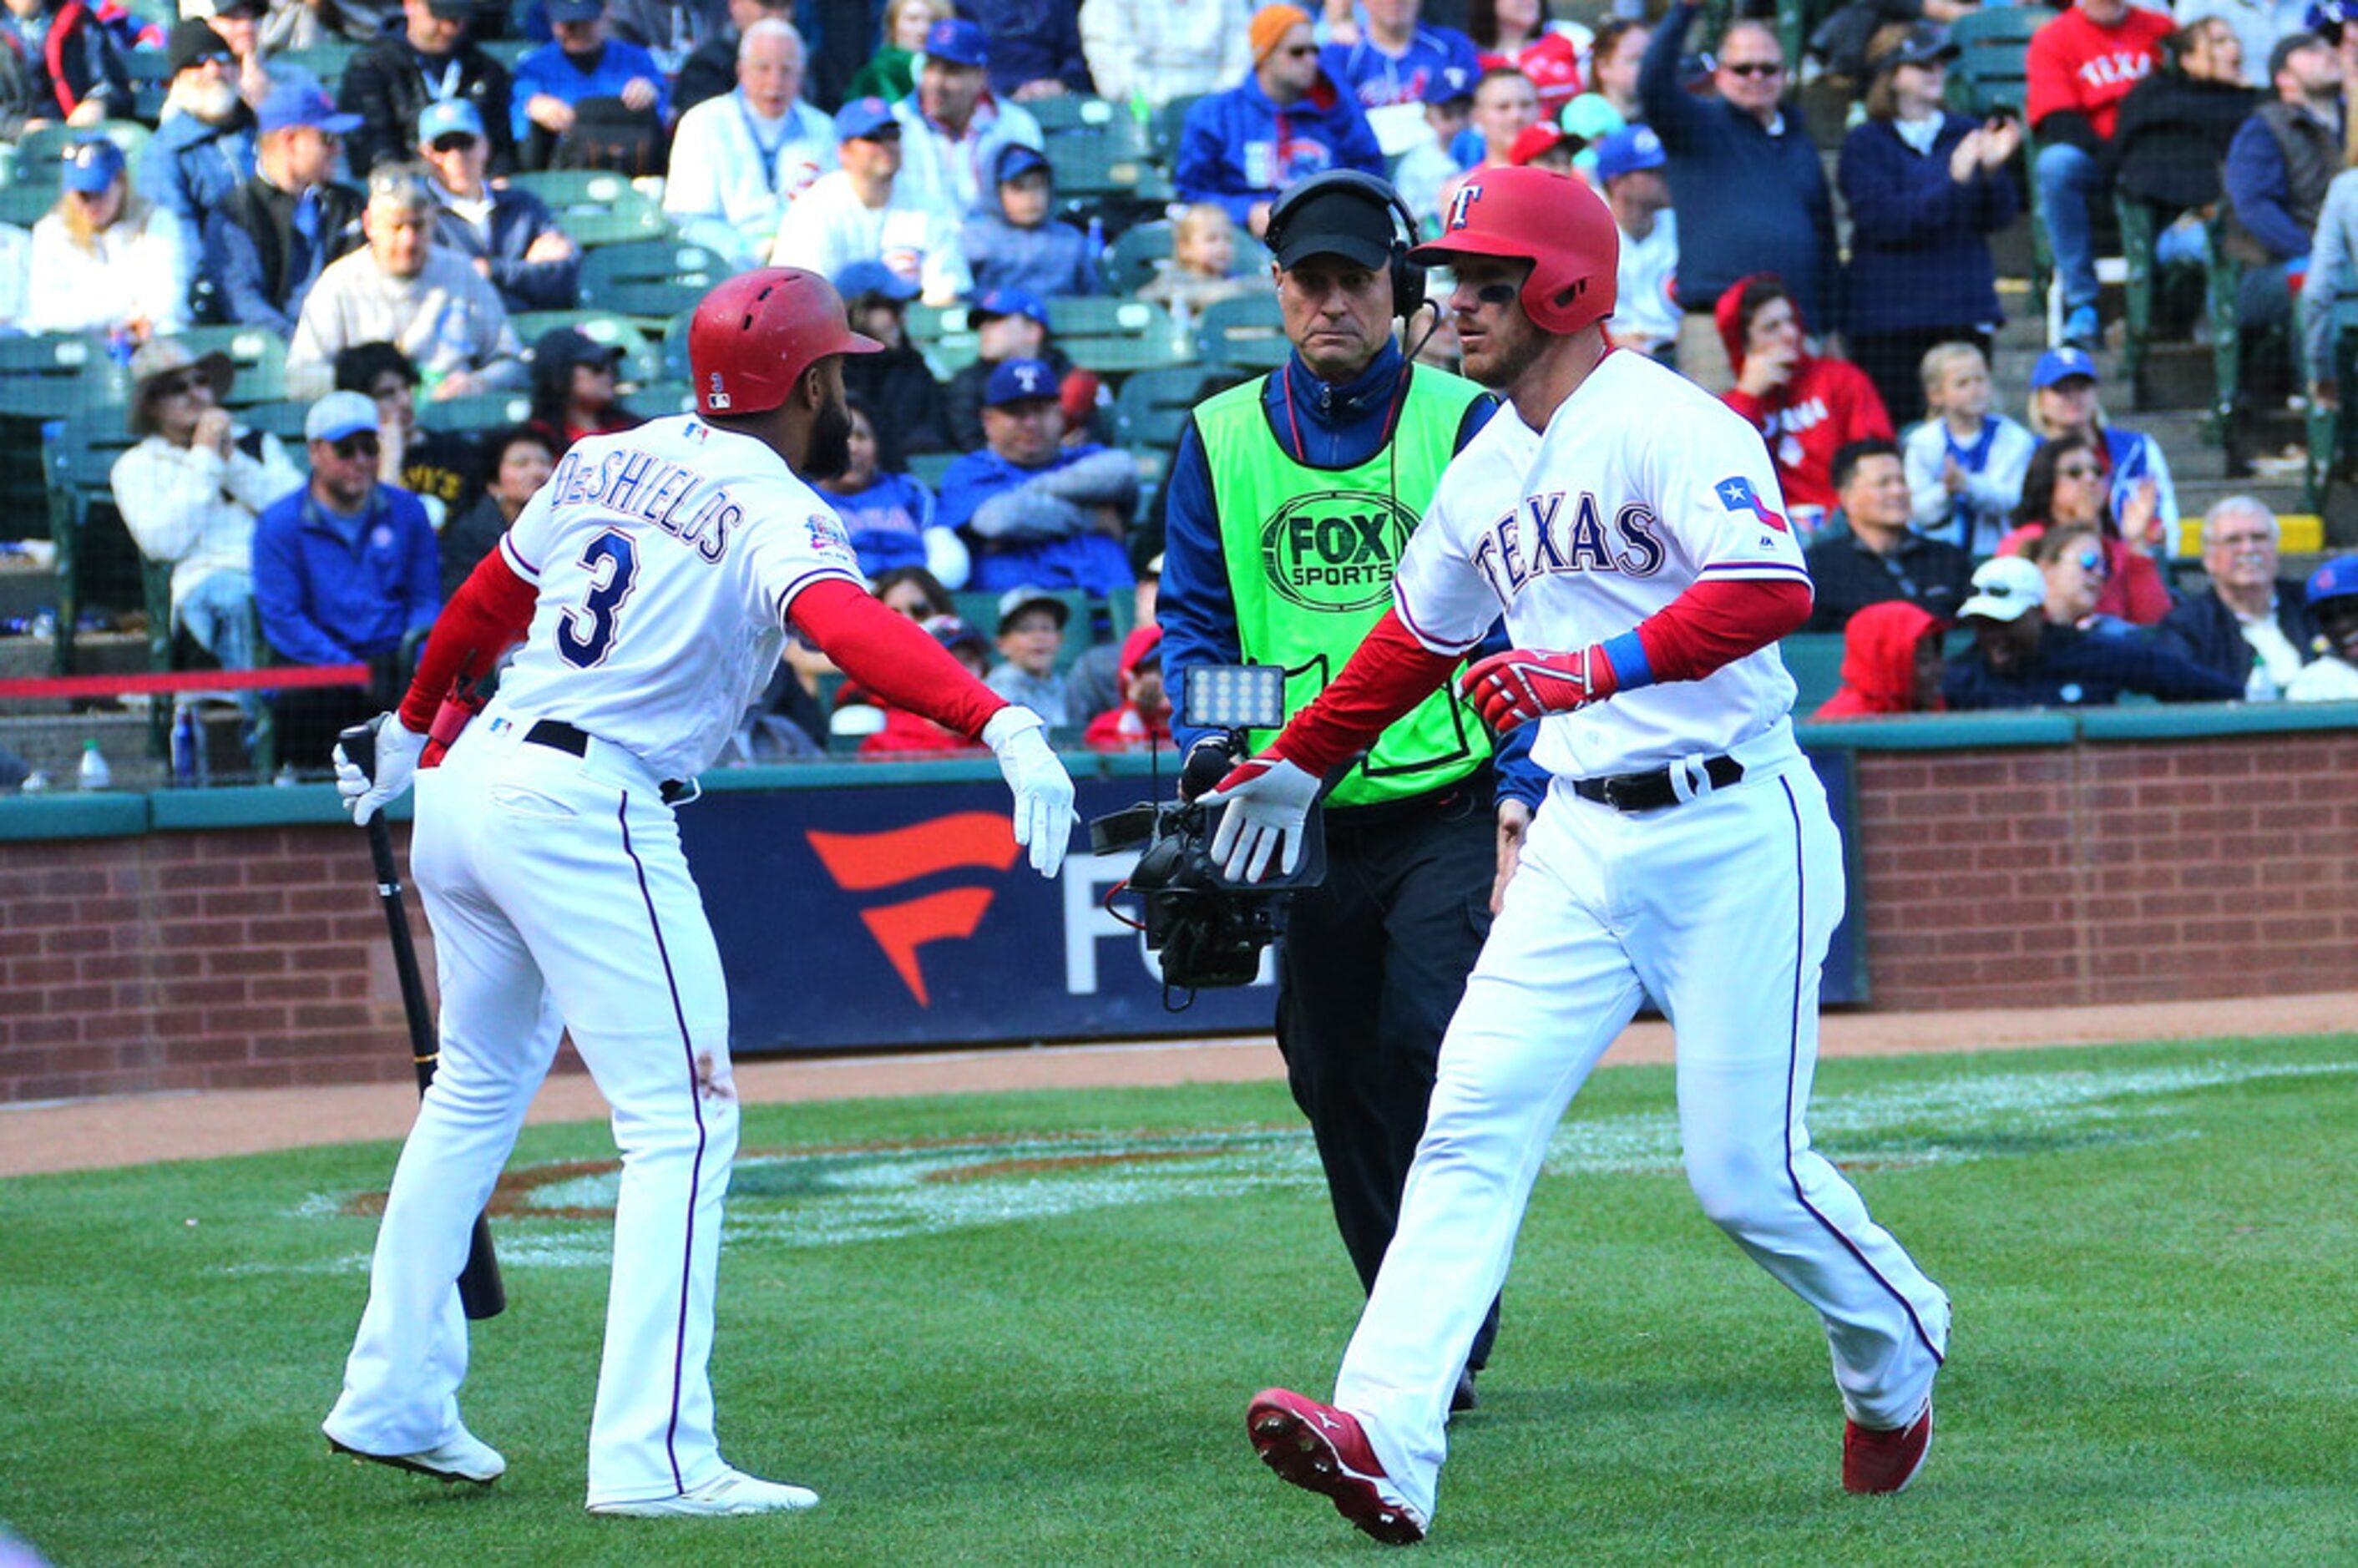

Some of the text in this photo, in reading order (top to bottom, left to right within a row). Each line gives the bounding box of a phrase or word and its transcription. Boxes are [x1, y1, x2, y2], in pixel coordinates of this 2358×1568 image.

[1451, 185, 1483, 229] T
[1289, 513, 1392, 565] FOX
[1470, 491, 1666, 614] TEXAS
[554, 525, 641, 670] 3
[1293, 564, 1394, 586] SPORTS
